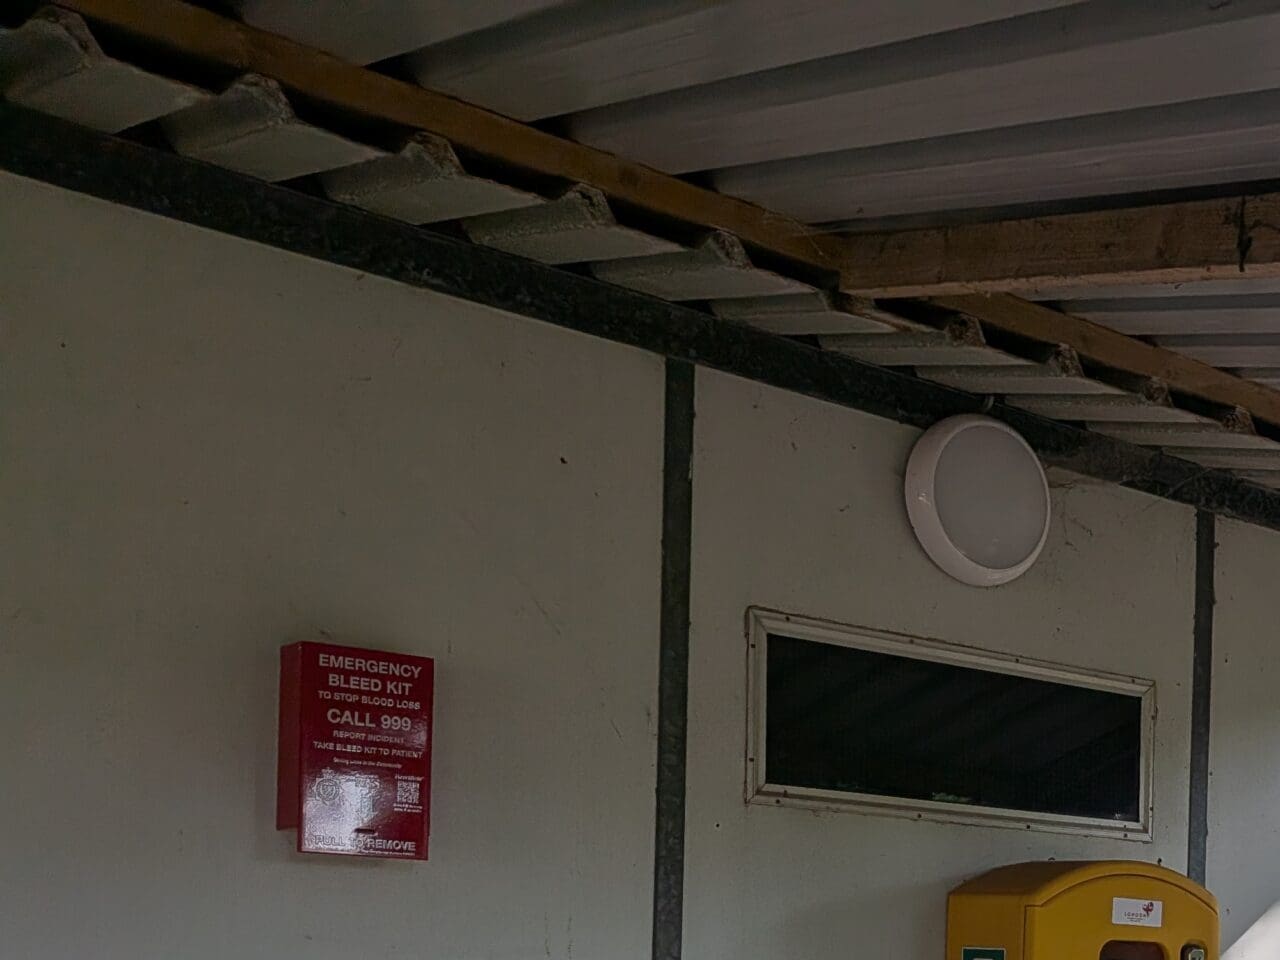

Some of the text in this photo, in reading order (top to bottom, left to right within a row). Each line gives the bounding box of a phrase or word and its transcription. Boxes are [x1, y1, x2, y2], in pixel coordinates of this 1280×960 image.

[319, 653, 422, 679] EMERGENCY
[328, 673, 413, 696] BLEED KIT
[318, 690, 421, 710] TO STOP BLOOD LOSS
[327, 708, 412, 731] CALL 999
[333, 730, 405, 744] REPORT INCIDENT
[313, 741, 423, 759] TAKE BLEED KIT TO PATIENT
[367, 838, 417, 851] REMOVE
